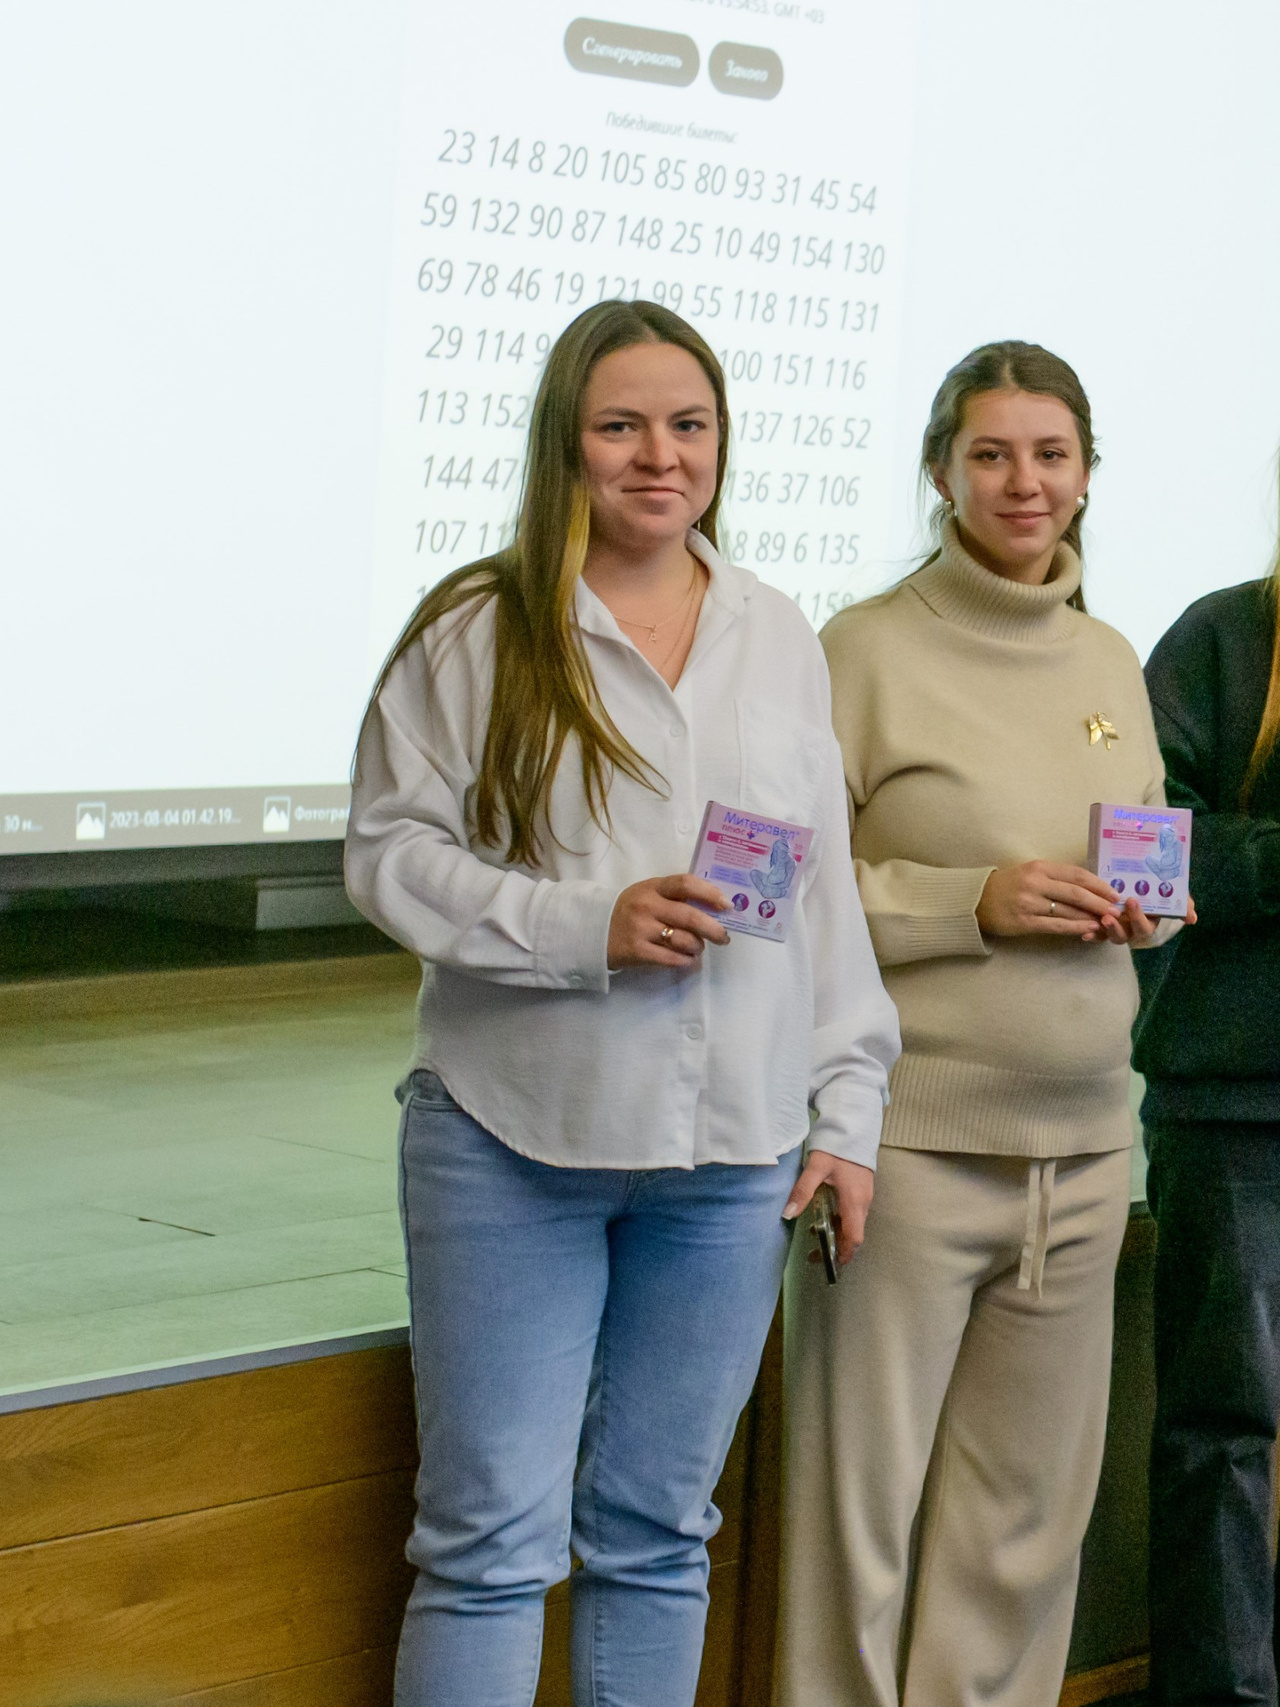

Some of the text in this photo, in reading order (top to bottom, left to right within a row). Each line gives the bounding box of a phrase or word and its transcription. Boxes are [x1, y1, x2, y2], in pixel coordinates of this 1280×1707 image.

[773, 2, 801, 19] GMT
[605, 110, 684, 137] Победившие
[437, 128, 877, 215] 23 14 8 20 105 85 80 93 31 45 54
[420, 192, 885, 275] 59 132 90 87 148 25 10 49 154 130
[417, 258, 879, 332] 69 78 46 19 121 99 55 118 115 131
[425, 324, 463, 360] 29
[477, 328, 525, 364] 114
[720, 349, 763, 382] 100
[774, 353, 813, 386] 151
[826, 358, 867, 390] 116
[418, 389, 871, 449] 113 152 137 126 52
[424, 454, 474, 490] 144
[727, 470, 771, 503] 136
[777, 472, 809, 504] 37
[819, 475, 860, 507] 106
[416, 519, 467, 554] 107
[755, 531, 786, 563] 89
[793, 532, 809, 563] 6
[820, 533, 860, 565] 135
[724, 811, 796, 840] Митеравел
